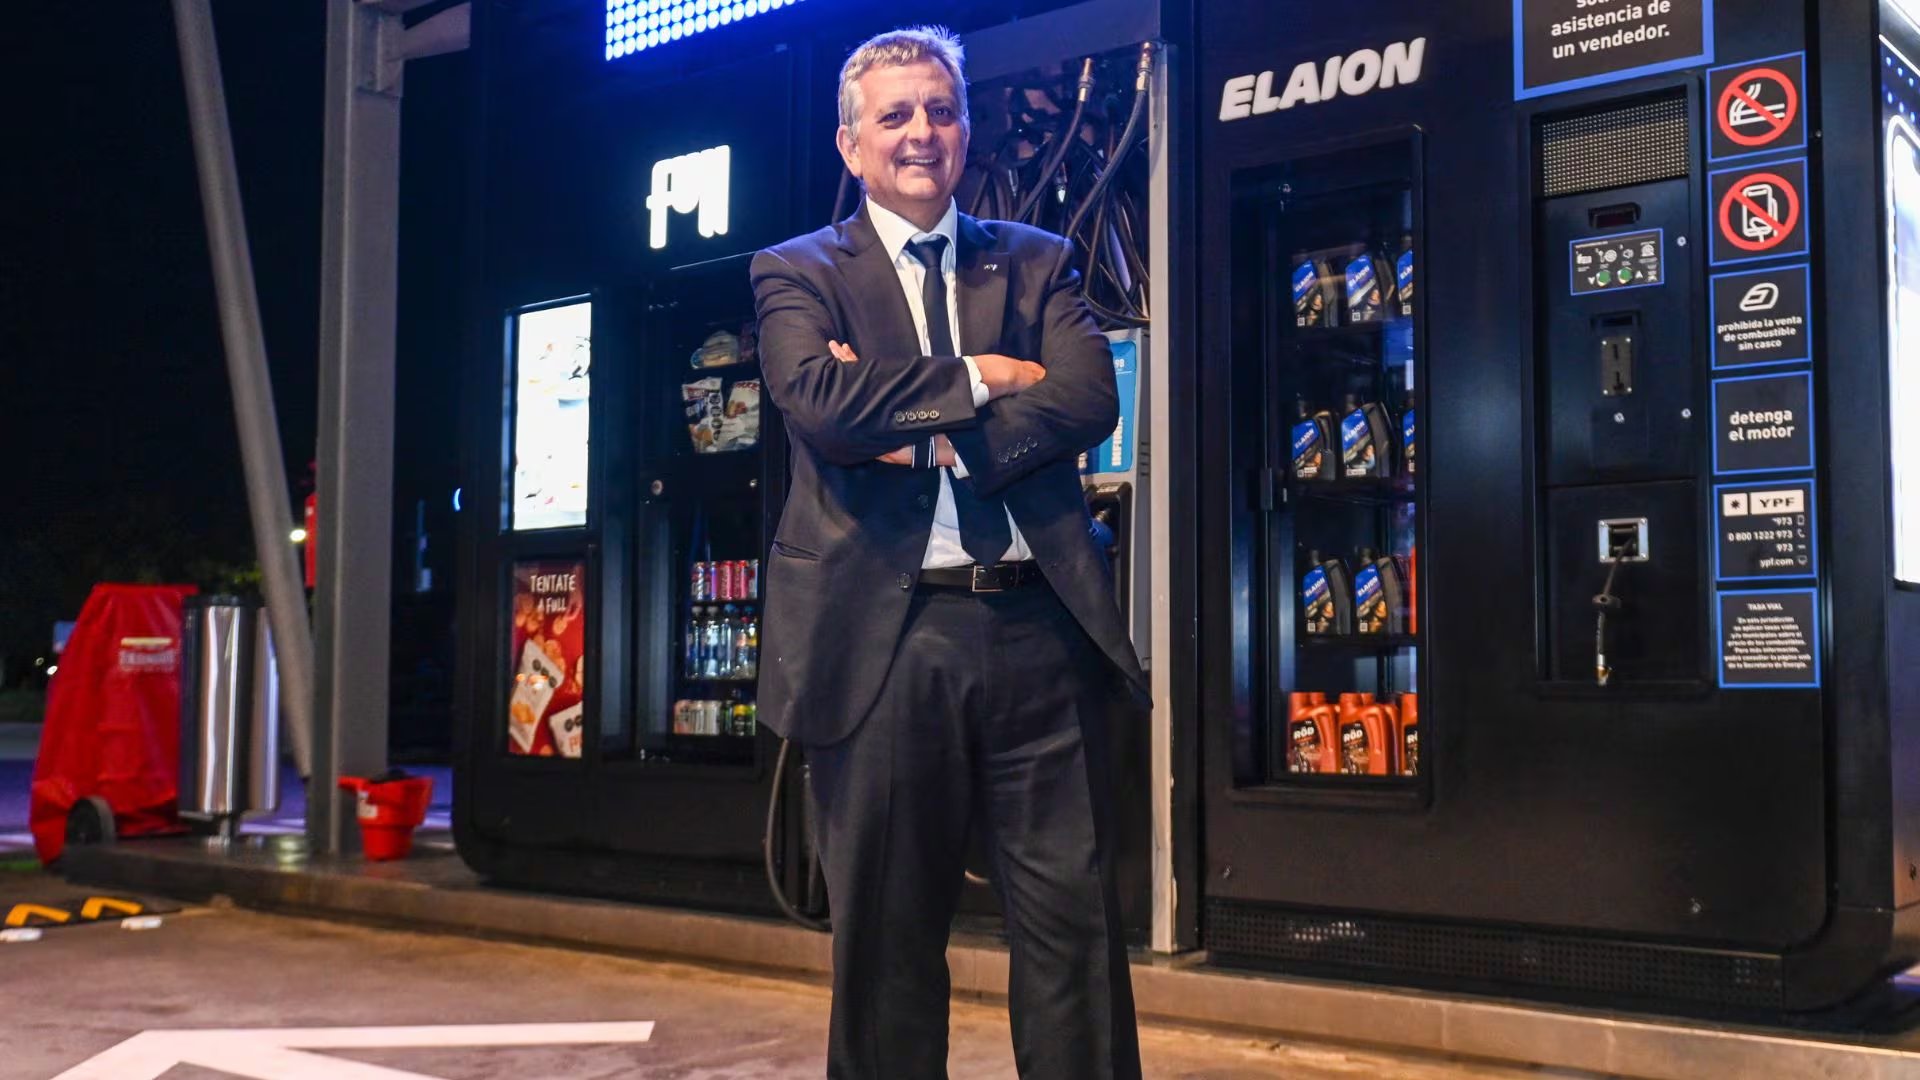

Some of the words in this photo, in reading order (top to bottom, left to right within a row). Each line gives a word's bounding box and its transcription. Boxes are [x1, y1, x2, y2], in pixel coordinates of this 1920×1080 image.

[1551, 4, 1642, 36] asistencia
[1647, 0, 1671, 16] de
[1552, 43, 1575, 59] un
[1580, 24, 1670, 53] vendedor.
[1219, 37, 1426, 122] ELAION
[1717, 319, 1763, 334] prohibida
[1764, 318, 1775, 328] la
[1775, 316, 1803, 326] venta
[1723, 333, 1736, 342] de
[1737, 326, 1797, 341] combustible
[1738, 341, 1754, 351] sin
[1755, 339, 1783, 349] casco
[1730, 409, 1793, 425] detenga
[1728, 427, 1745, 441] el
[1747, 425, 1795, 440] motor
[1759, 497, 1795, 508] YPF
[1728, 532, 1734, 541] 0
[1735, 531, 1752, 541] 800
[1776, 530, 1793, 539] 973
[1776, 543, 1793, 552] 973
[1759, 557, 1794, 569] ypf.com
[530, 574, 577, 593] TENTATE
[546, 597, 567, 614] FULL
